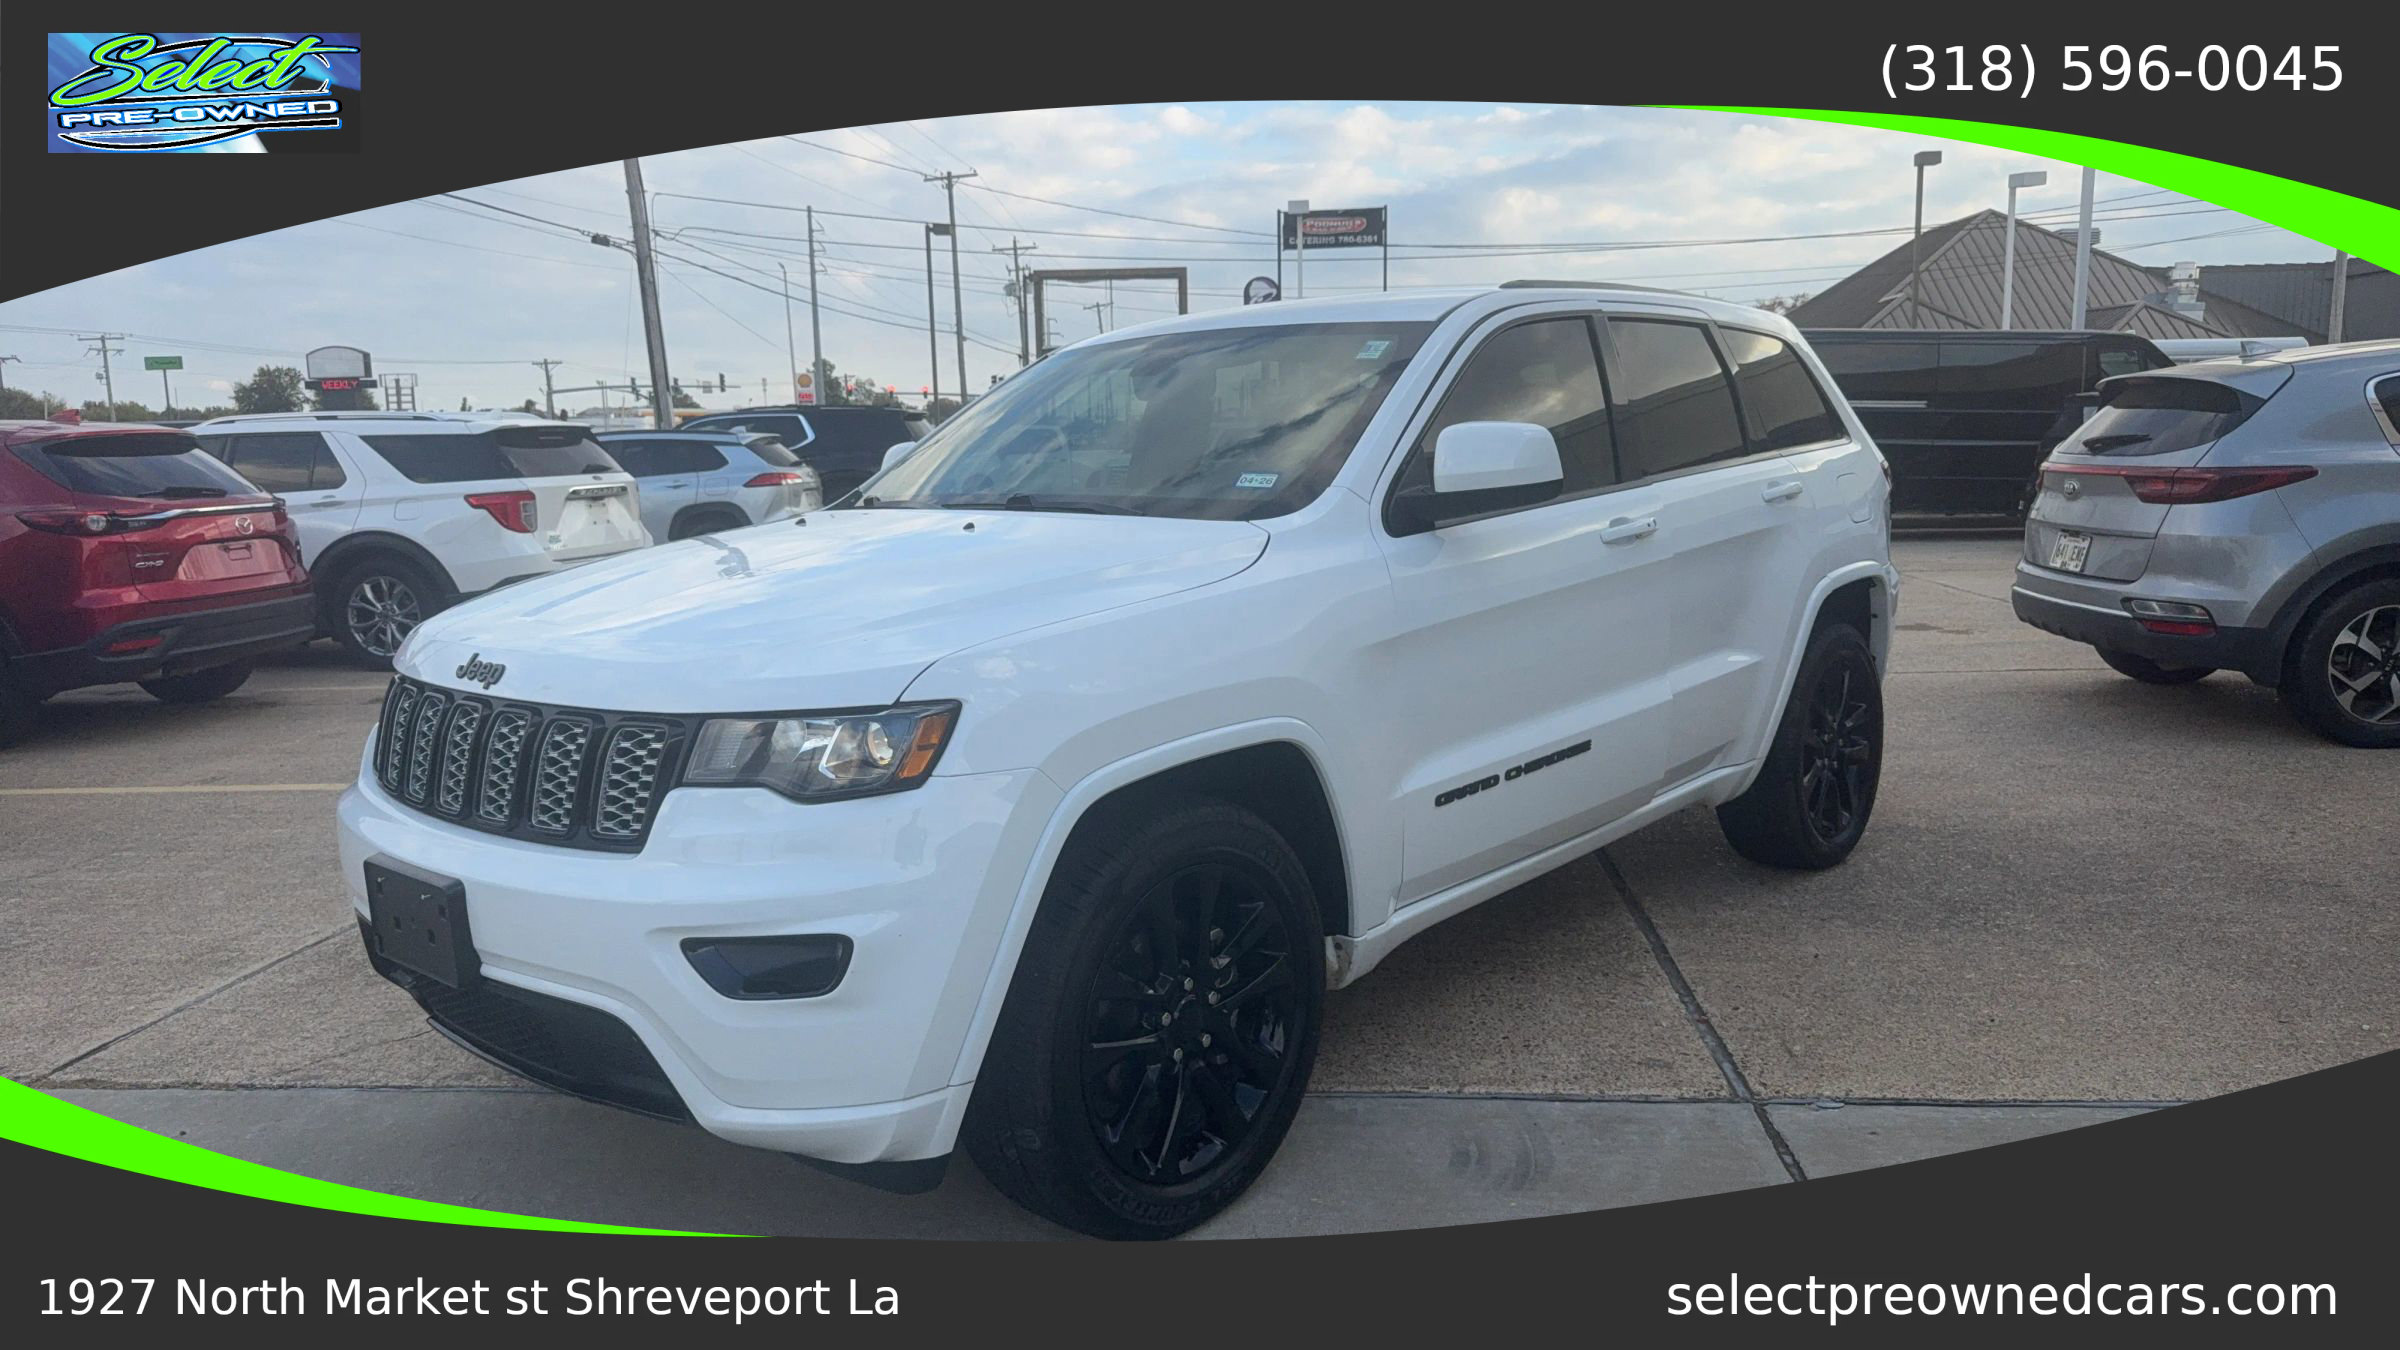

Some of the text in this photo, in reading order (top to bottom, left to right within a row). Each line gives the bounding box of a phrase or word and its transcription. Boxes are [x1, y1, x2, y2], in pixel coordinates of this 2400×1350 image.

[321, 379, 358, 389] WEEKLY
[456, 652, 506, 690] Jeep
[1434, 774, 1500, 807] GRAND
